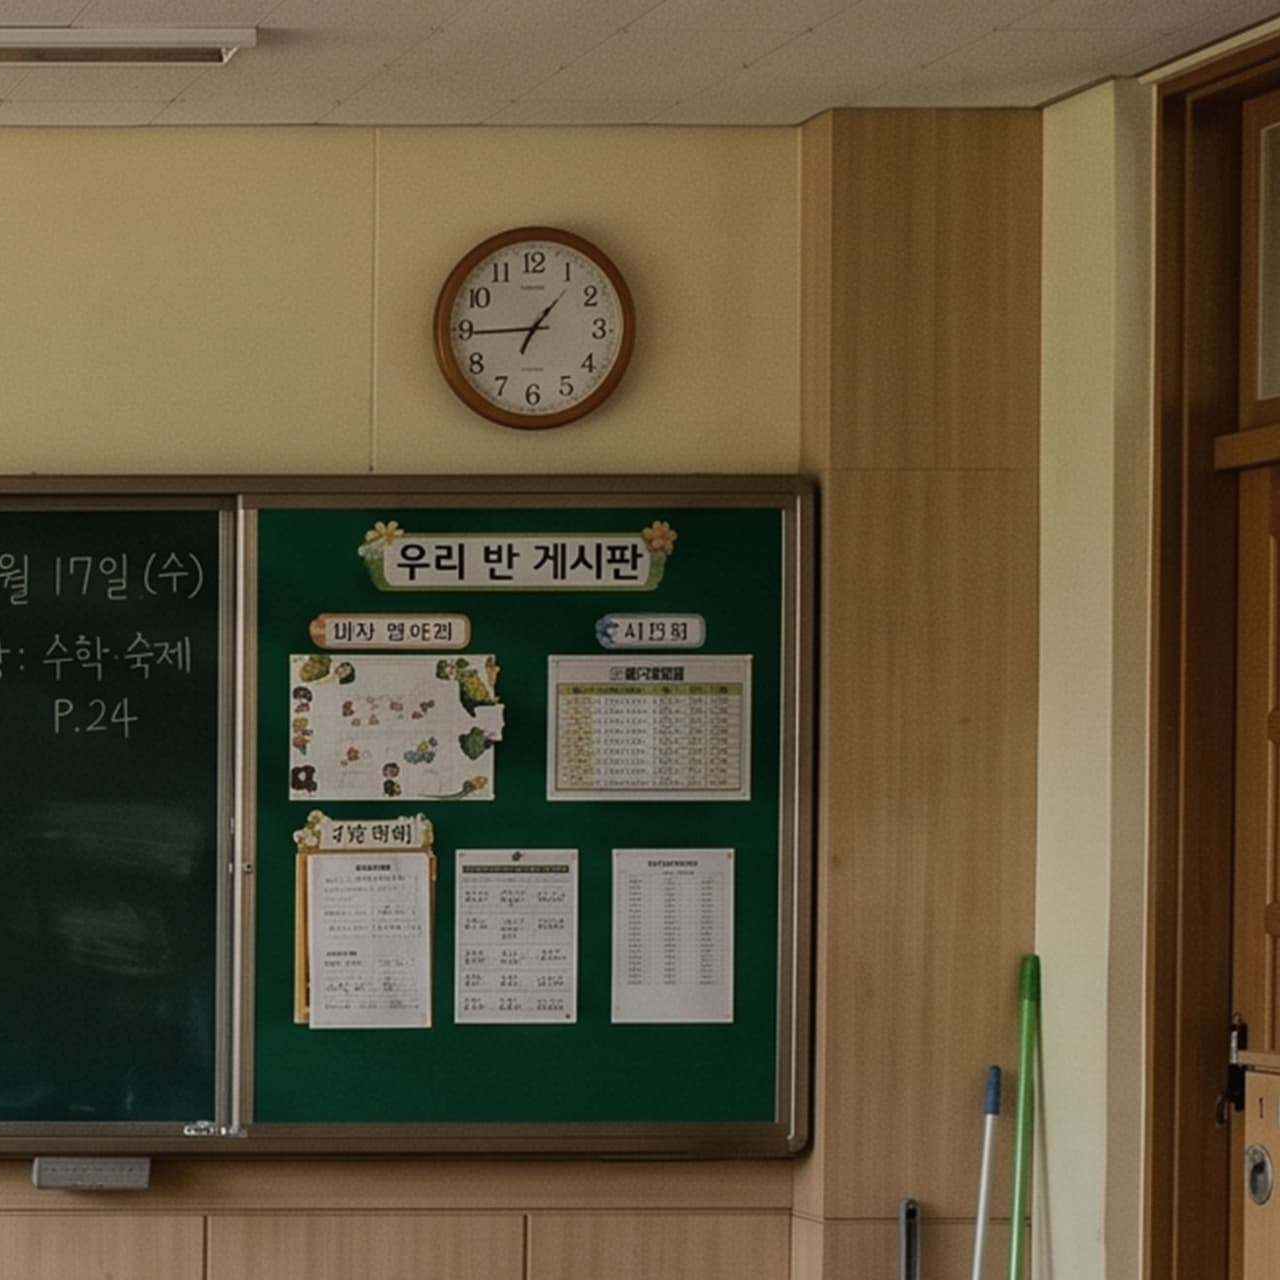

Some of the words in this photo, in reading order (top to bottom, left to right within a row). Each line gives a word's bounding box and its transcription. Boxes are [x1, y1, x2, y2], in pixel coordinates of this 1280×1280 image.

[492, 262, 510, 283] 11
[523, 251, 546, 274] 12
[565, 262, 571, 282] 1
[469, 287, 491, 309] 10
[583, 285, 599, 307] 2
[458, 319, 474, 341] 9
[592, 318, 607, 340] 3
[468, 352, 485, 375] 8
[581, 352, 596, 373] 4
[494, 375, 509, 396] 7
[525, 384, 540, 406] 6
[559, 375, 574, 396] 5
[395, 544, 466, 581] 우리
[481, 544, 521, 581] 반
[533, 543, 644, 582] 게시판
[55, 553, 128, 600] 17일
[143, 551, 204, 600] (수)
[54, 697, 139, 739] P.24
